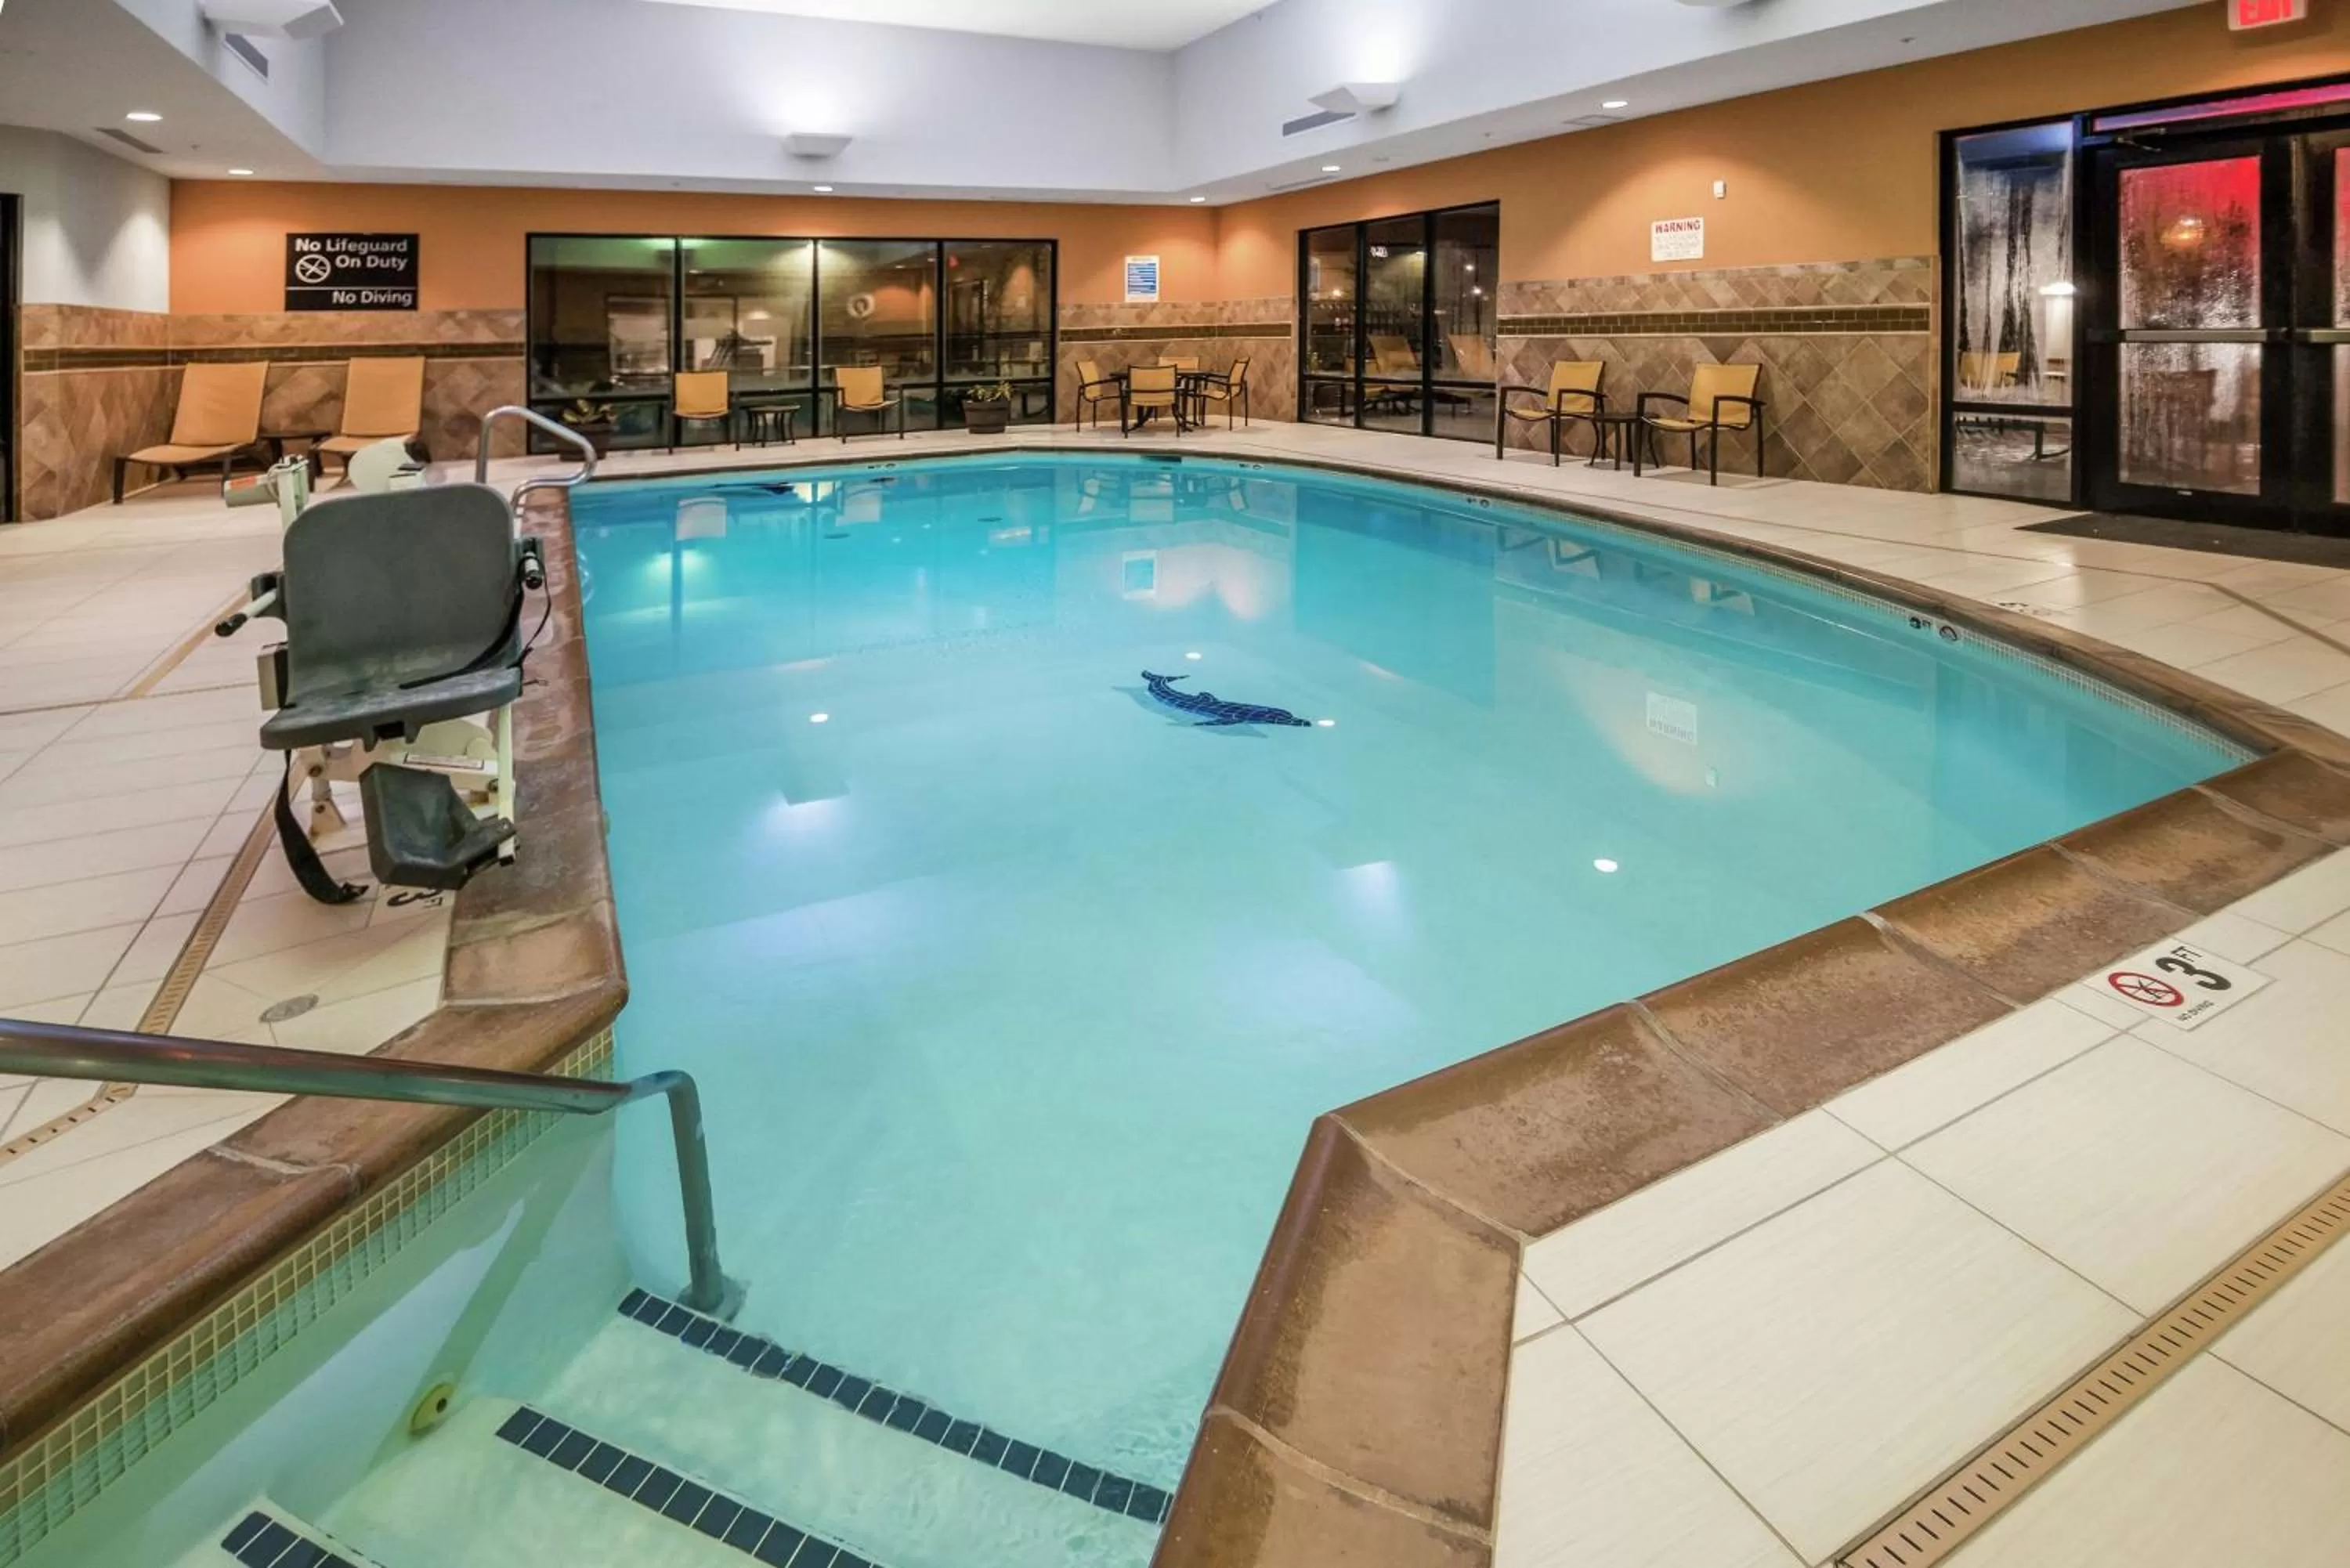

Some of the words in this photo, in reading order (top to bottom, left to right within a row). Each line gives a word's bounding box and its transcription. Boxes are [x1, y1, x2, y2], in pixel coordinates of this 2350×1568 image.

[1655, 219, 1701, 233] WARNING
[295, 238, 321, 251] No
[326, 238, 407, 254] Lifeguard
[335, 255, 361, 268] On
[366, 255, 408, 271] Duty
[332, 291, 356, 304] No
[360, 291, 413, 306] Diving
[2171, 945, 2204, 963] FT
[2155, 956, 2232, 991] 3
